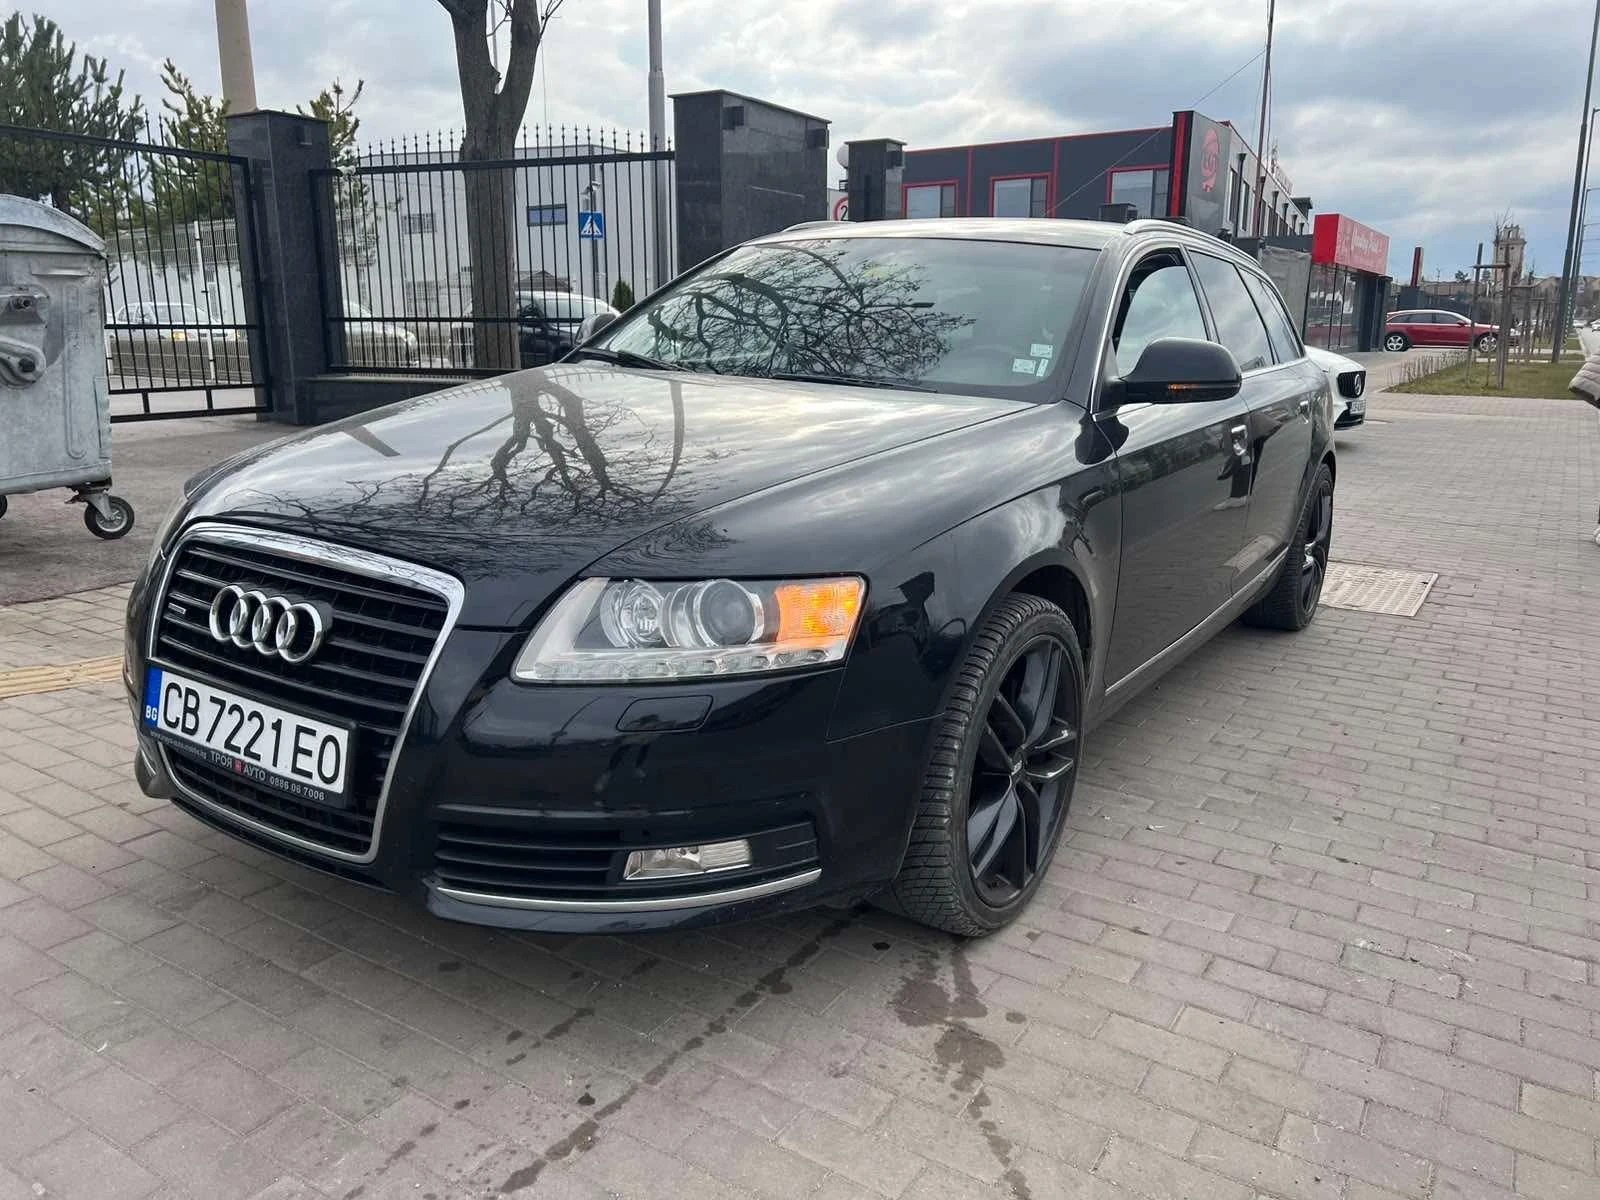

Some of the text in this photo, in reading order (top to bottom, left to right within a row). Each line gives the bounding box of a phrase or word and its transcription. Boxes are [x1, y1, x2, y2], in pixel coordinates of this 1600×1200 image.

[145, 704, 159, 722] BG
[205, 695, 283, 769] 7221
[210, 750, 266, 782] ТРОЯ АУТО
